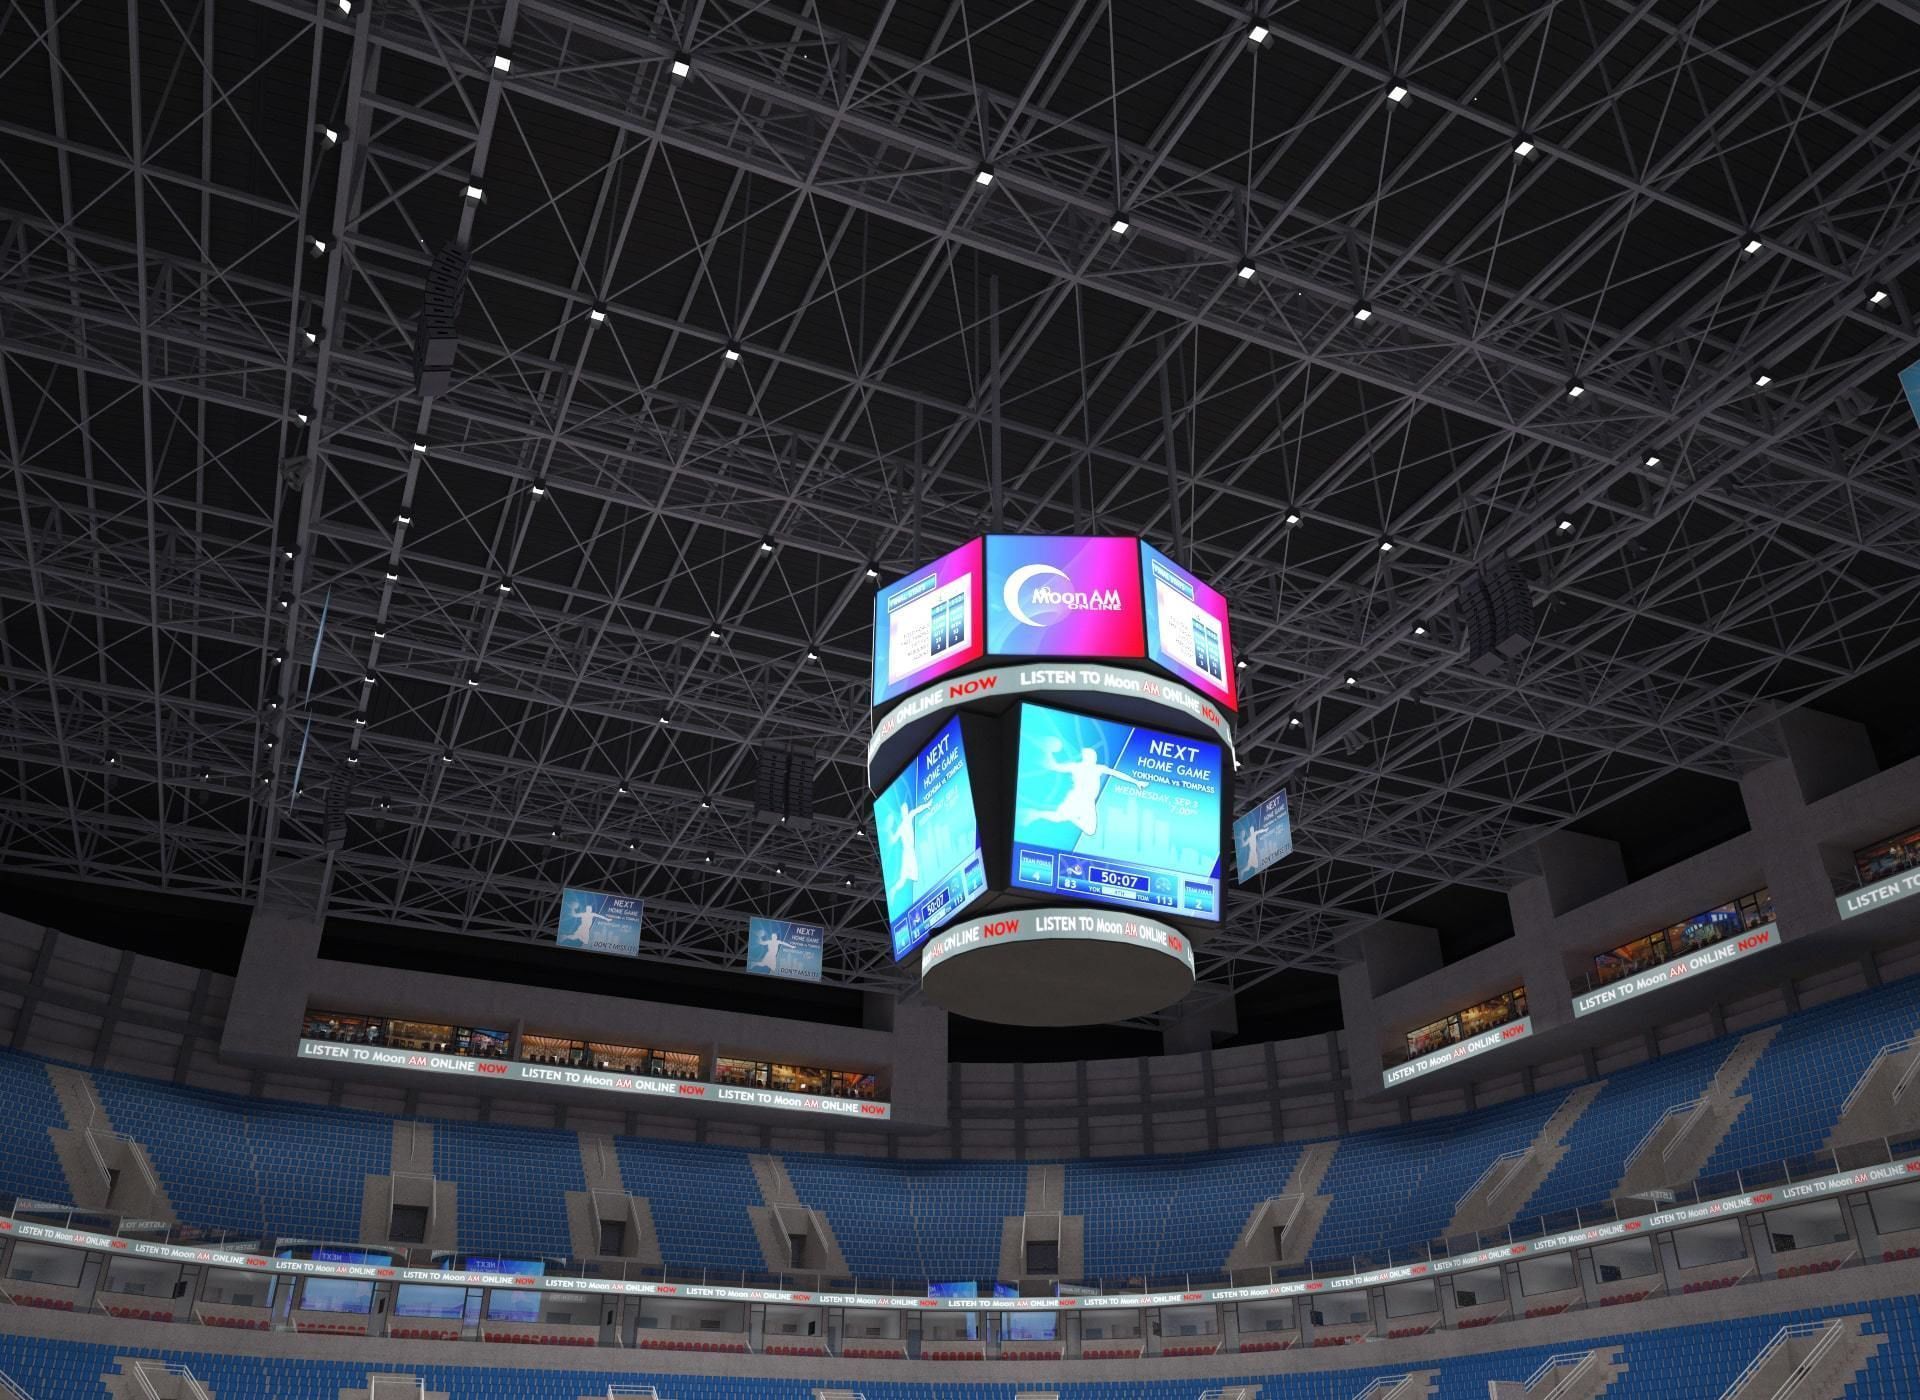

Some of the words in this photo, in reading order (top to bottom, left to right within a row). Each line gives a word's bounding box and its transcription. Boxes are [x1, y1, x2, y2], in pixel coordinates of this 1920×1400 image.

[1032, 588, 1087, 604] Moon
[1089, 589, 1121, 605] AM
[896, 689, 944, 724] ONLINE
[950, 676, 997, 698] NOW
[1020, 670, 1075, 685] LISTEN
[1080, 670, 1100, 684] TO
[1104, 673, 1139, 690] Moon
[1143, 681, 1160, 695] AM
[1162, 688, 1200, 714] ONLINE
[1201, 704, 1221, 726] NOW
[926, 734, 949, 770] NEXT
[1149, 740, 1200, 762] NEXT
[924, 767, 940, 789] HOME
[942, 747, 958, 771] GAME
[1137, 756, 1173, 772] HOME
[1177, 765, 1210, 780] GAME
[1132, 770, 1171, 784] YOKHOMA
[1182, 781, 1215, 793] TOMPASS
[1033, 872, 1040, 880] 4
[1101, 872, 1139, 888] 50:07
[614, 899, 635, 908] NEXT
[928, 894, 944, 916] 50:07
[1156, 895, 1172, 905] 113
[1196, 900, 1202, 909] 2
[1848, 883, 1900, 911] LISTEN
[796, 928, 815, 936] NEXT
[944, 926, 980, 952] ONLINE
[984, 919, 1019, 938] NOW
[1036, 916, 1076, 932] LISTEN
[1078, 916, 1094, 931] TO
[1096, 918, 1123, 935] Moon
[1124, 922, 1137, 937] AM
[1139, 926, 1167, 945] ONLINE
[1168, 935, 1183, 950] NOW
[1579, 989, 1616, 1010] LISTEN
[1617, 983, 1633, 995] TO
[1636, 972, 1666, 989] Moon
[1670, 964, 1686, 976] AM
[1689, 944, 1734, 968] ONLINE
[1737, 931, 1768, 952] NOW
[305, 1044, 348, 1056] LISTEN
[352, 1049, 369, 1059] TO
[372, 1051, 404, 1063] Moon
[408, 1056, 426, 1065] AM
[430, 1057, 474, 1070] ONLINE
[477, 1063, 507, 1072] NOW
[1388, 1065, 1414, 1081] LISTEN
[1416, 1060, 1426, 1071] TO
[1429, 1053, 1451, 1066] Moon
[1453, 1047, 1465, 1056] AM
[1468, 1033, 1500, 1052] ONLINE
[1503, 1024, 1525, 1039] NOW
[521, 1068, 560, 1080] LISTEN
[564, 1072, 579, 1082] TO
[582, 1074, 612, 1086] Moon
[615, 1078, 631, 1088] AM
[635, 1080, 675, 1092] ONLINE
[678, 1085, 704, 1094] NOW
[718, 1089, 754, 1100] LISTEN
[757, 1093, 770, 1103] TO
[774, 1095, 801, 1106] Moon
[804, 1099, 818, 1108] AM
[822, 1100, 858, 1112] ONLINE
[861, 1104, 884, 1114] NOW
[1783, 1184, 1812, 1197] LISTEN
[1813, 1181, 1825, 1191] TO
[1828, 1177, 1852, 1188] Moon
[1854, 1173, 1867, 1183] AM
[1870, 1165, 1904, 1179] ONLINE
[1905, 1161, 1920, 1171] NO
[1650, 1213, 1674, 1225] LISTEN
[1675, 1211, 1685, 1220] TO
[1688, 1208, 1707, 1217] Moon
[1709, 1203, 1721, 1213] AM
[1722, 1197, 1751, 1210] ONLINE
[1752, 1193, 1773, 1203] NOW
[19, 1225, 42, 1235] LISTEN
[44, 1229, 53, 1237] TO
[54, 1231, 72, 1241] Moon
[73, 1234, 84, 1243] AM
[85, 1236, 110, 1246] ONLINE
[111, 1240, 127, 1248] NOW
[1534, 1238, 1556, 1249] LISTEN
[1558, 1236, 1566, 1244] TO
[1568, 1233, 1586, 1242] Moon
[1587, 1231, 1597, 1239] AM
[1599, 1224, 1624, 1236] ONLINE
[1624, 1221, 1641, 1230] NOW
[276, 1261, 301, 1269] LISTEN
[315, 1264, 334, 1272] Moon
[335, 1265, 347, 1274] AM
[348, 1266, 375, 1275] ONLINE
[377, 1268, 395, 1276] NOW
[442, 1273, 464, 1281] Moon
[467, 1274, 479, 1284] AM
[482, 1275, 512, 1283] ONLINE
[545, 1279, 573, 1287] LISTEN
[576, 1280, 586, 1288] TO
[611, 1283, 623, 1291] AM
[625, 1283, 654, 1292] ONLINE
[656, 1285, 676, 1293] NOW
[1212, 1290, 1237, 1299] LISTEN
[1270, 1287, 1279, 1295] AM
[1280, 1283, 1304, 1293] ONLINE
[1305, 1281, 1323, 1290] NOW
[819, 1295, 842, 1303] LISTEN
[856, 1296, 876, 1304] Moon
[877, 1297, 888, 1306] AM
[890, 1298, 917, 1306] ONLINE
